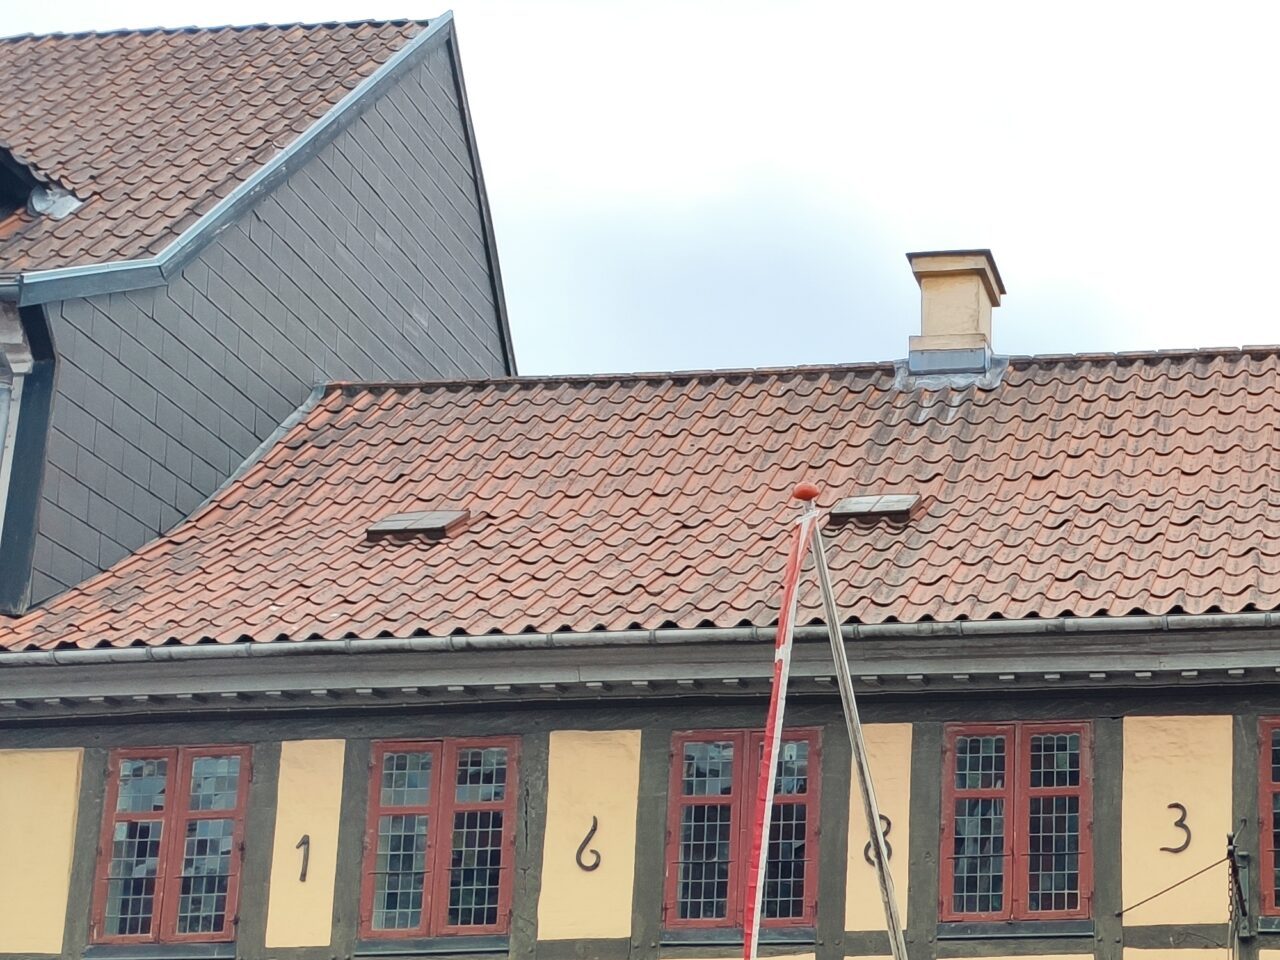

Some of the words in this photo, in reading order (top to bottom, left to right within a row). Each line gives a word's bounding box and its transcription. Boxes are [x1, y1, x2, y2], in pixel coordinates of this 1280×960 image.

[296, 834, 310, 882] 1
[576, 815, 601, 871] 6
[864, 813, 892, 867] 8
[1160, 802, 1191, 853] 3
